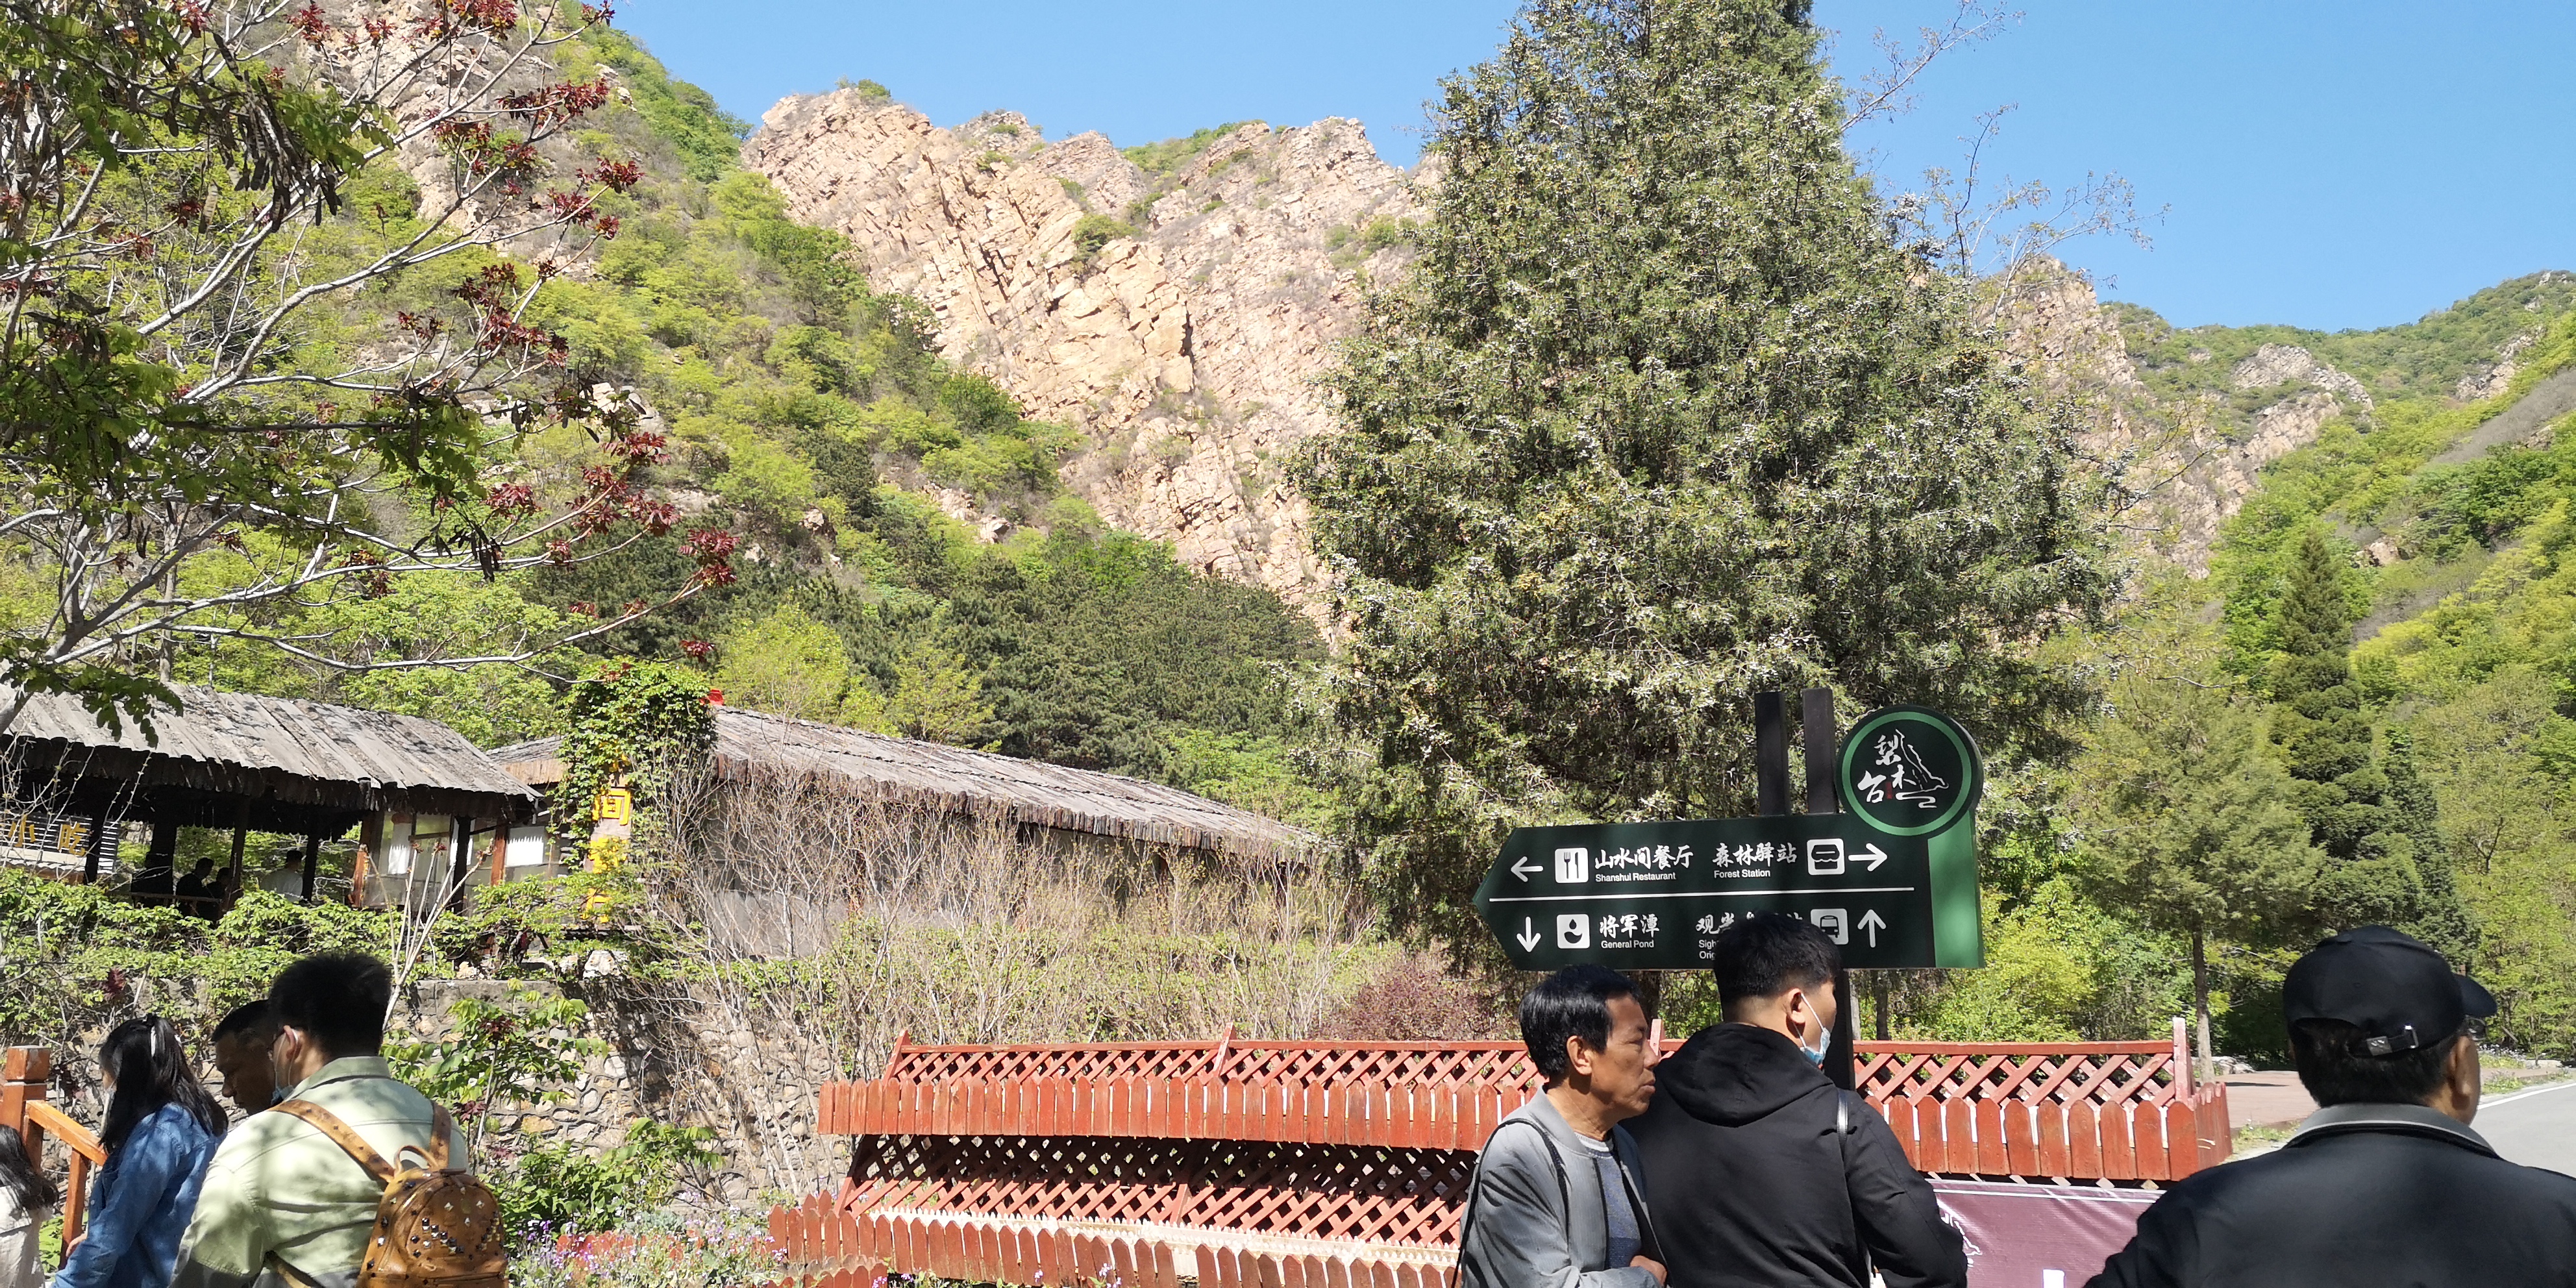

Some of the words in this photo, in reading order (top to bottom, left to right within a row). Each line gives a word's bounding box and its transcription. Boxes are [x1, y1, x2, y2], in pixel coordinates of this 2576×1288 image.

[7, 813, 87, 857] 小吃
[1594, 844, 1694, 871] 山水间餐厅
[1712, 842, 1797, 868] 森林驿站
[1595, 873, 1631, 882] Shanshui
[1632, 871, 1676, 882] Restaurant
[1714, 869, 1740, 878] Forest
[1741, 868, 1771, 878] Station
[1599, 913, 1660, 938] 将军潭
[1601, 940, 1632, 948] General
[1633, 939, 1654, 948] Pond
[1698, 939, 1719, 950] Sigh
